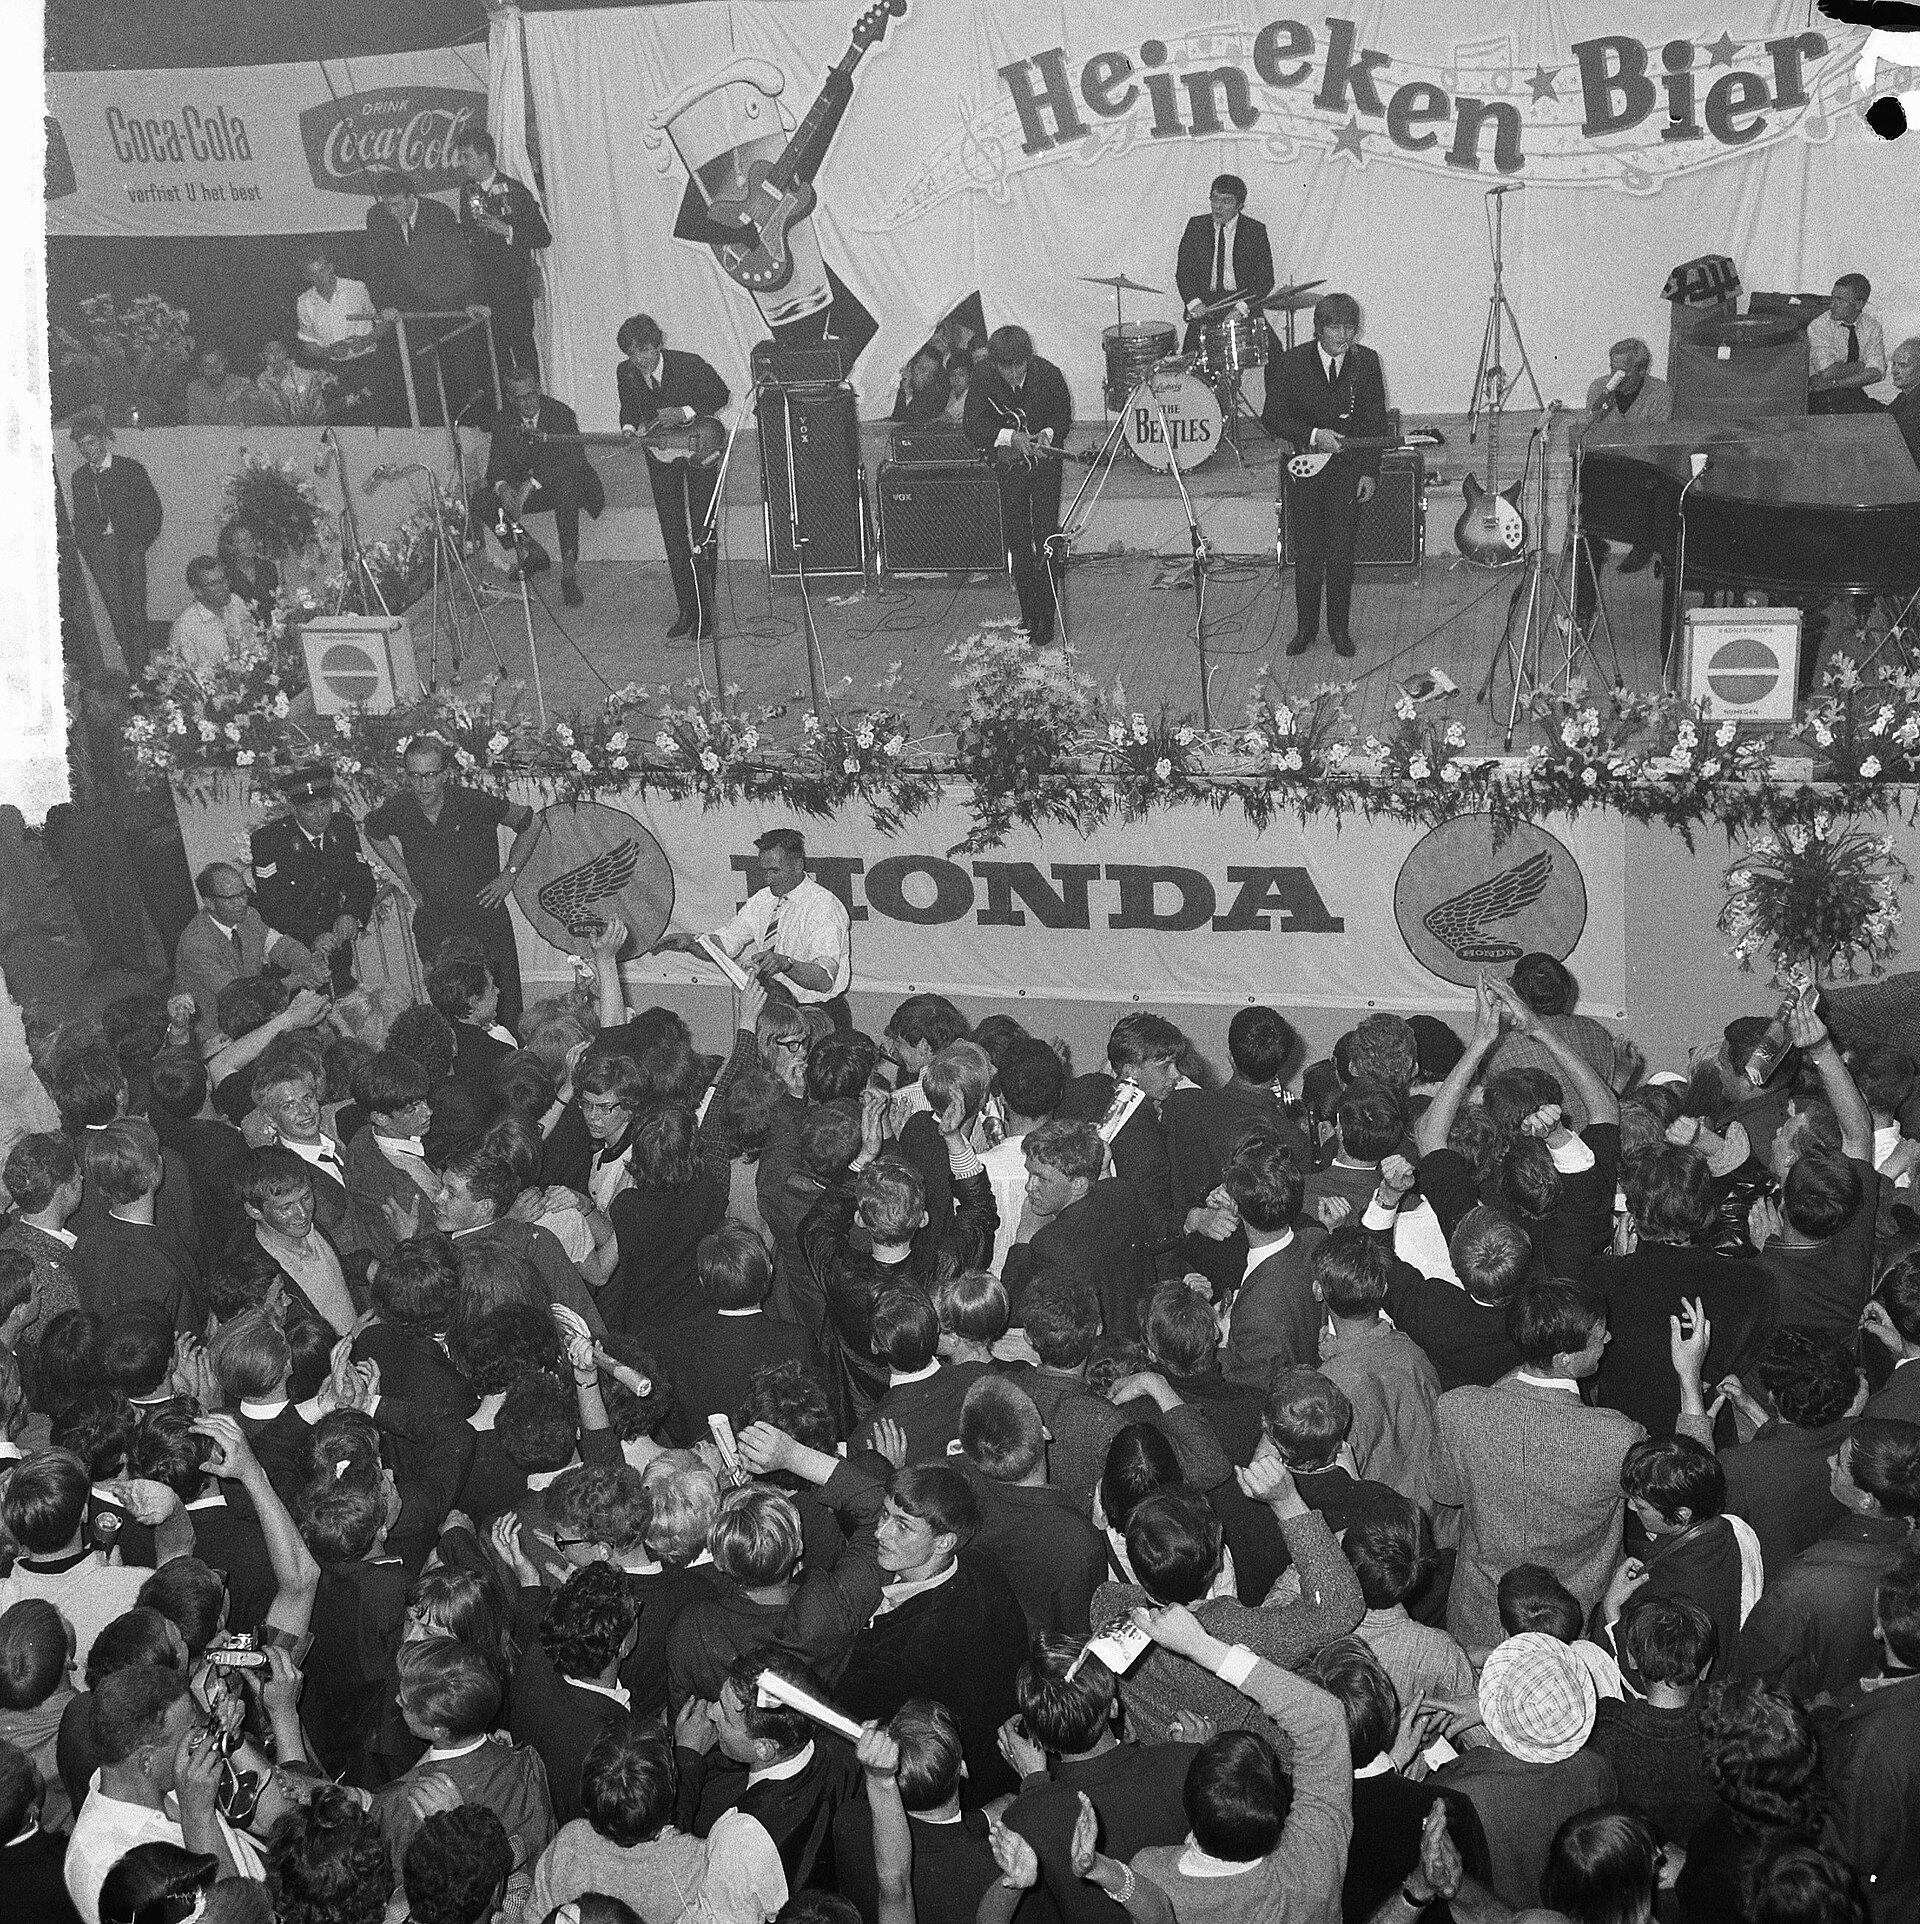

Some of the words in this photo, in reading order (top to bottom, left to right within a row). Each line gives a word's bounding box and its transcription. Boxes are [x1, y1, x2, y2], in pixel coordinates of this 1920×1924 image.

[998, 17, 1525, 173] Heineken
[1571, 31, 1829, 145] Bier
[362, 101, 409, 116] DRINK
[105, 105, 252, 163] Coca-Cola
[127, 183, 182, 203] verfrist
[185, 182, 197, 202] U
[200, 182, 226, 202] het
[229, 182, 263, 202] best
[1159, 404, 1180, 414] THE
[800, 416, 808, 442] VOX
[892, 493, 912, 501] VOX
[730, 854, 1345, 932] HONDA
[1462, 949, 1517, 957] HONDA
